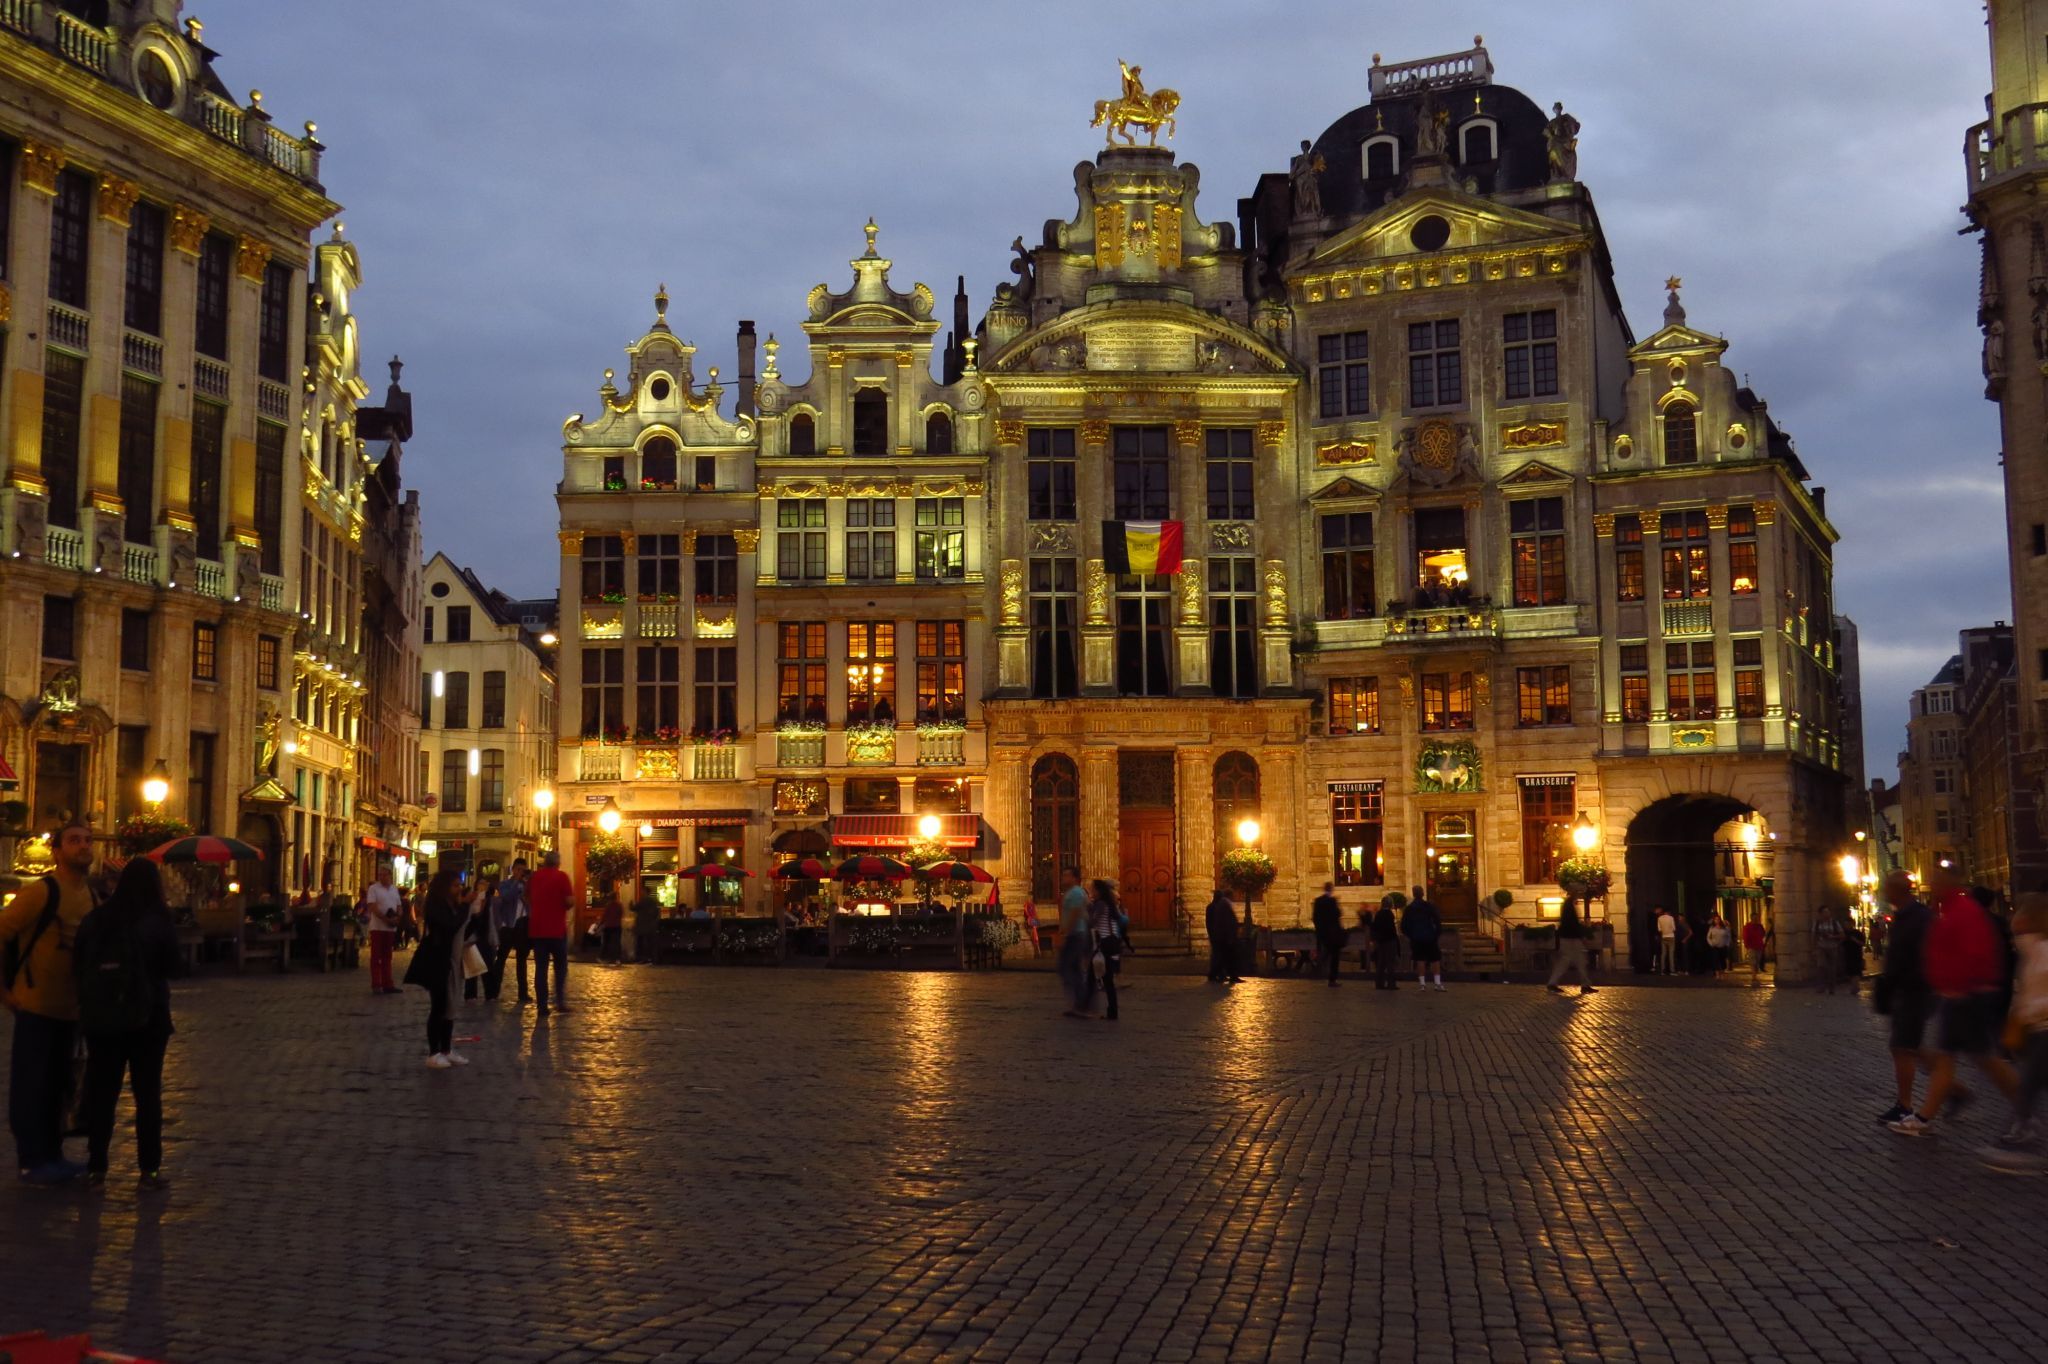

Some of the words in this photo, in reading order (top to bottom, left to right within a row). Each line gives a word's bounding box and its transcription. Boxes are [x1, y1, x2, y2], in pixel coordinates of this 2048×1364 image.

[992, 314, 1028, 329] ANNO
[1254, 318, 1288, 329] 1698
[1001, 393, 1053, 406] MAISON
[1525, 777, 1569, 786] BRASSERIE
[1334, 784, 1375, 793] RESTAURANT
[657, 818, 695, 827] DIAMONDS
[874, 837, 886, 846] La
[888, 837, 908, 846] Rose
